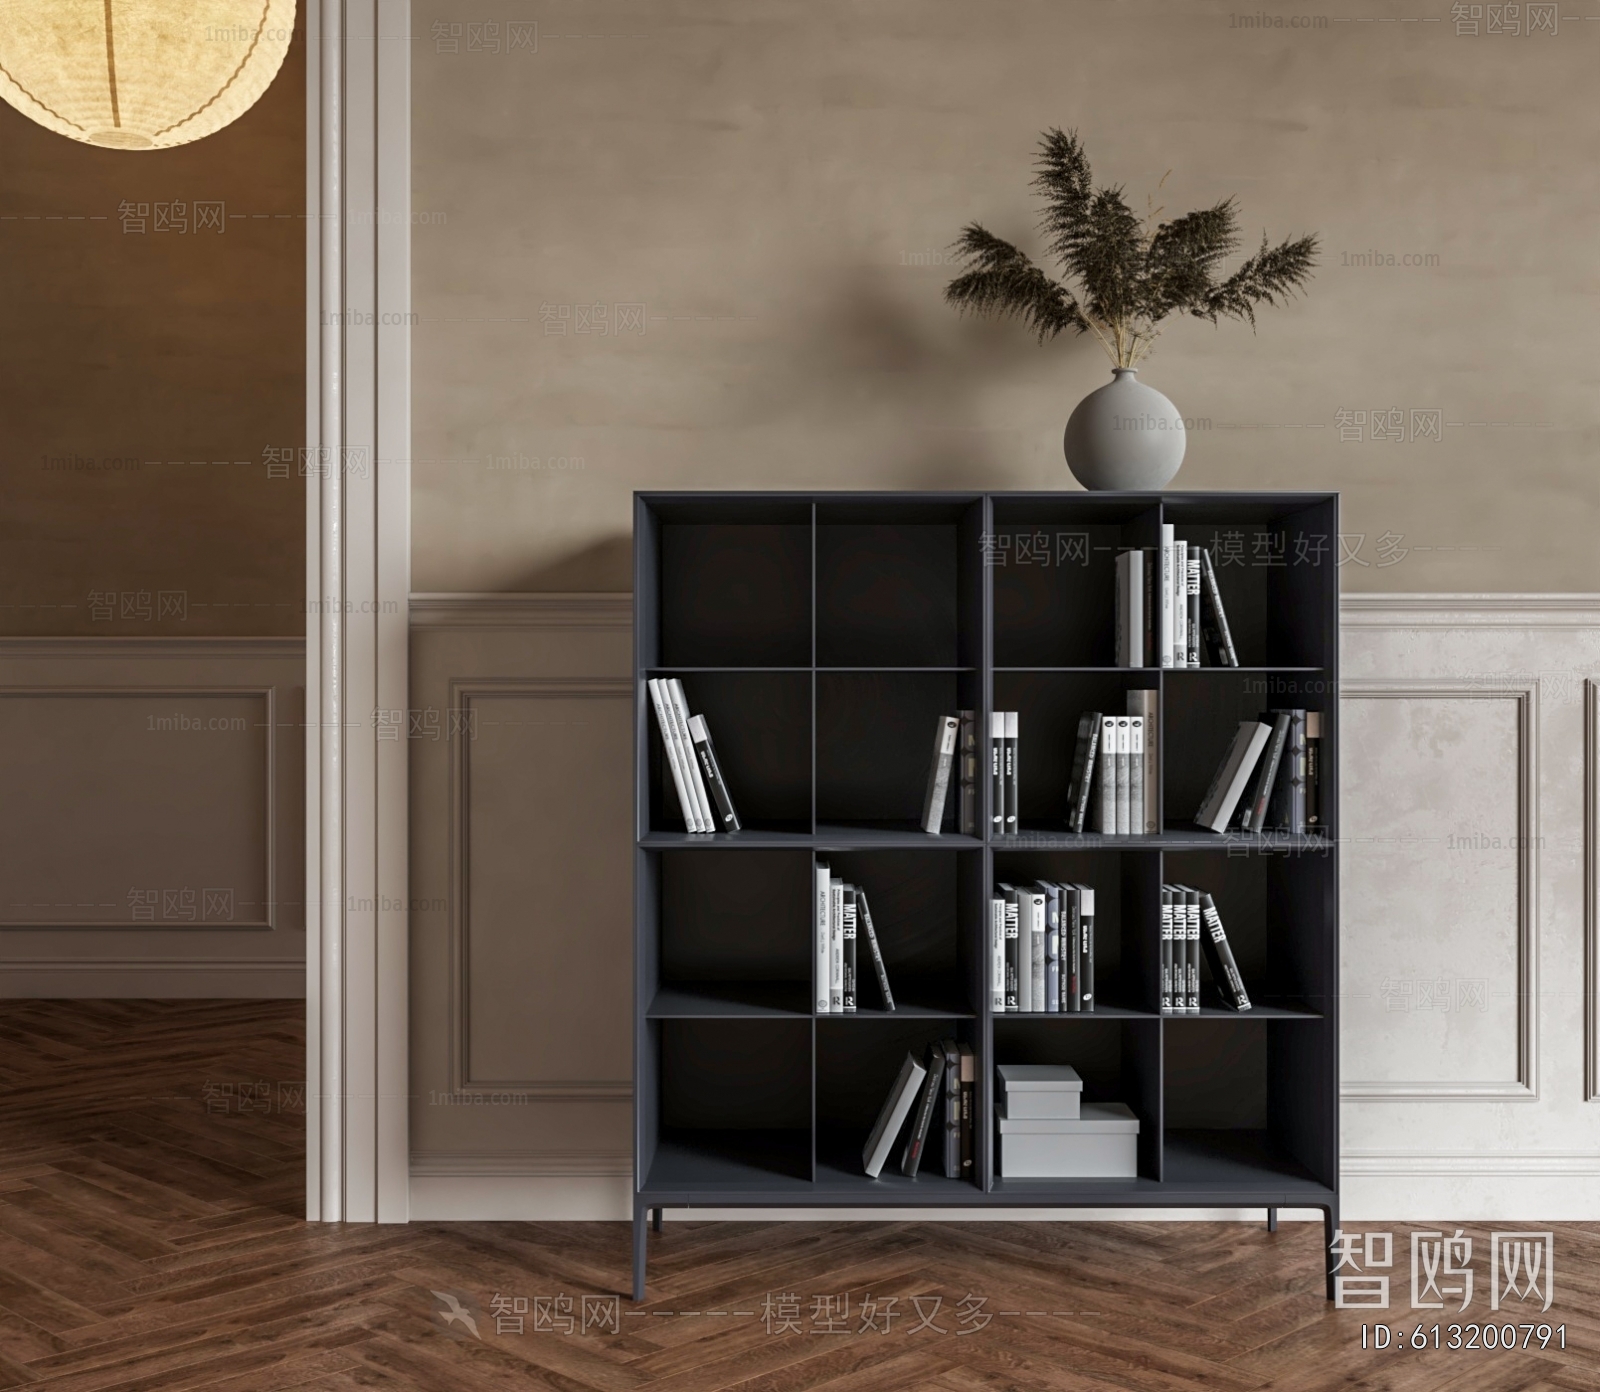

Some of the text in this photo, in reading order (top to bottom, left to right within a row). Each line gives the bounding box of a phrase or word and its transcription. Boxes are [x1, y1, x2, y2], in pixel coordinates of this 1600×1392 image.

[1187, 559, 1200, 595] MATTER
[843, 903, 856, 939] MATTER
[1005, 903, 1018, 939] MATTER
[1162, 904, 1173, 940] MATTER
[1174, 904, 1186, 940] MATTER
[1187, 904, 1200, 940] MATTER
[1203, 906, 1227, 943] MATTER
